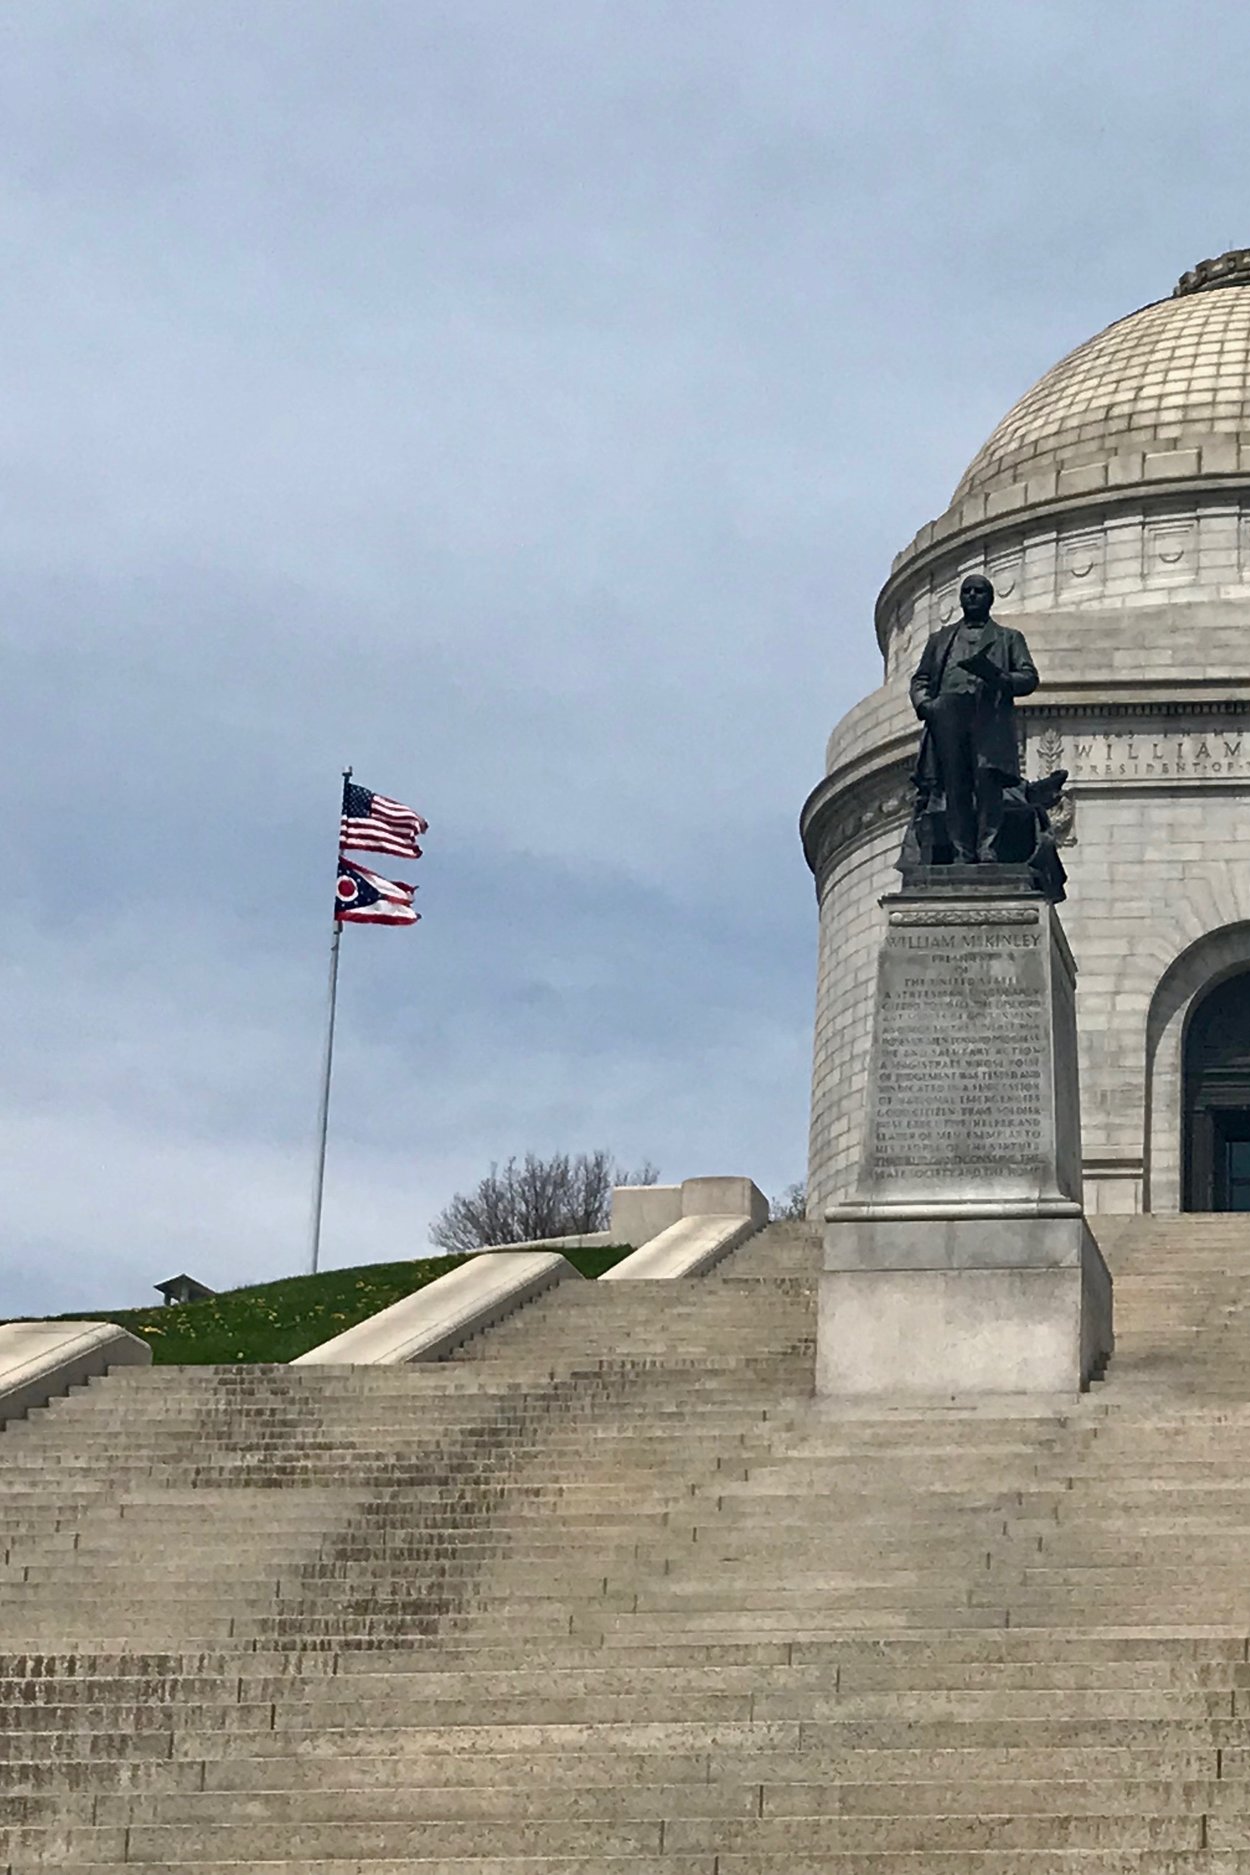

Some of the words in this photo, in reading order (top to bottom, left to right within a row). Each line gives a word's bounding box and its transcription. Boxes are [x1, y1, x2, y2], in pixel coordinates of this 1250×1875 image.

[1163, 727, 1192, 738] IN
[1073, 741, 1242, 760] WILLIAM
[1074, 762, 1201, 775] PRESIDENT
[885, 934, 956, 949] WILLIAM
